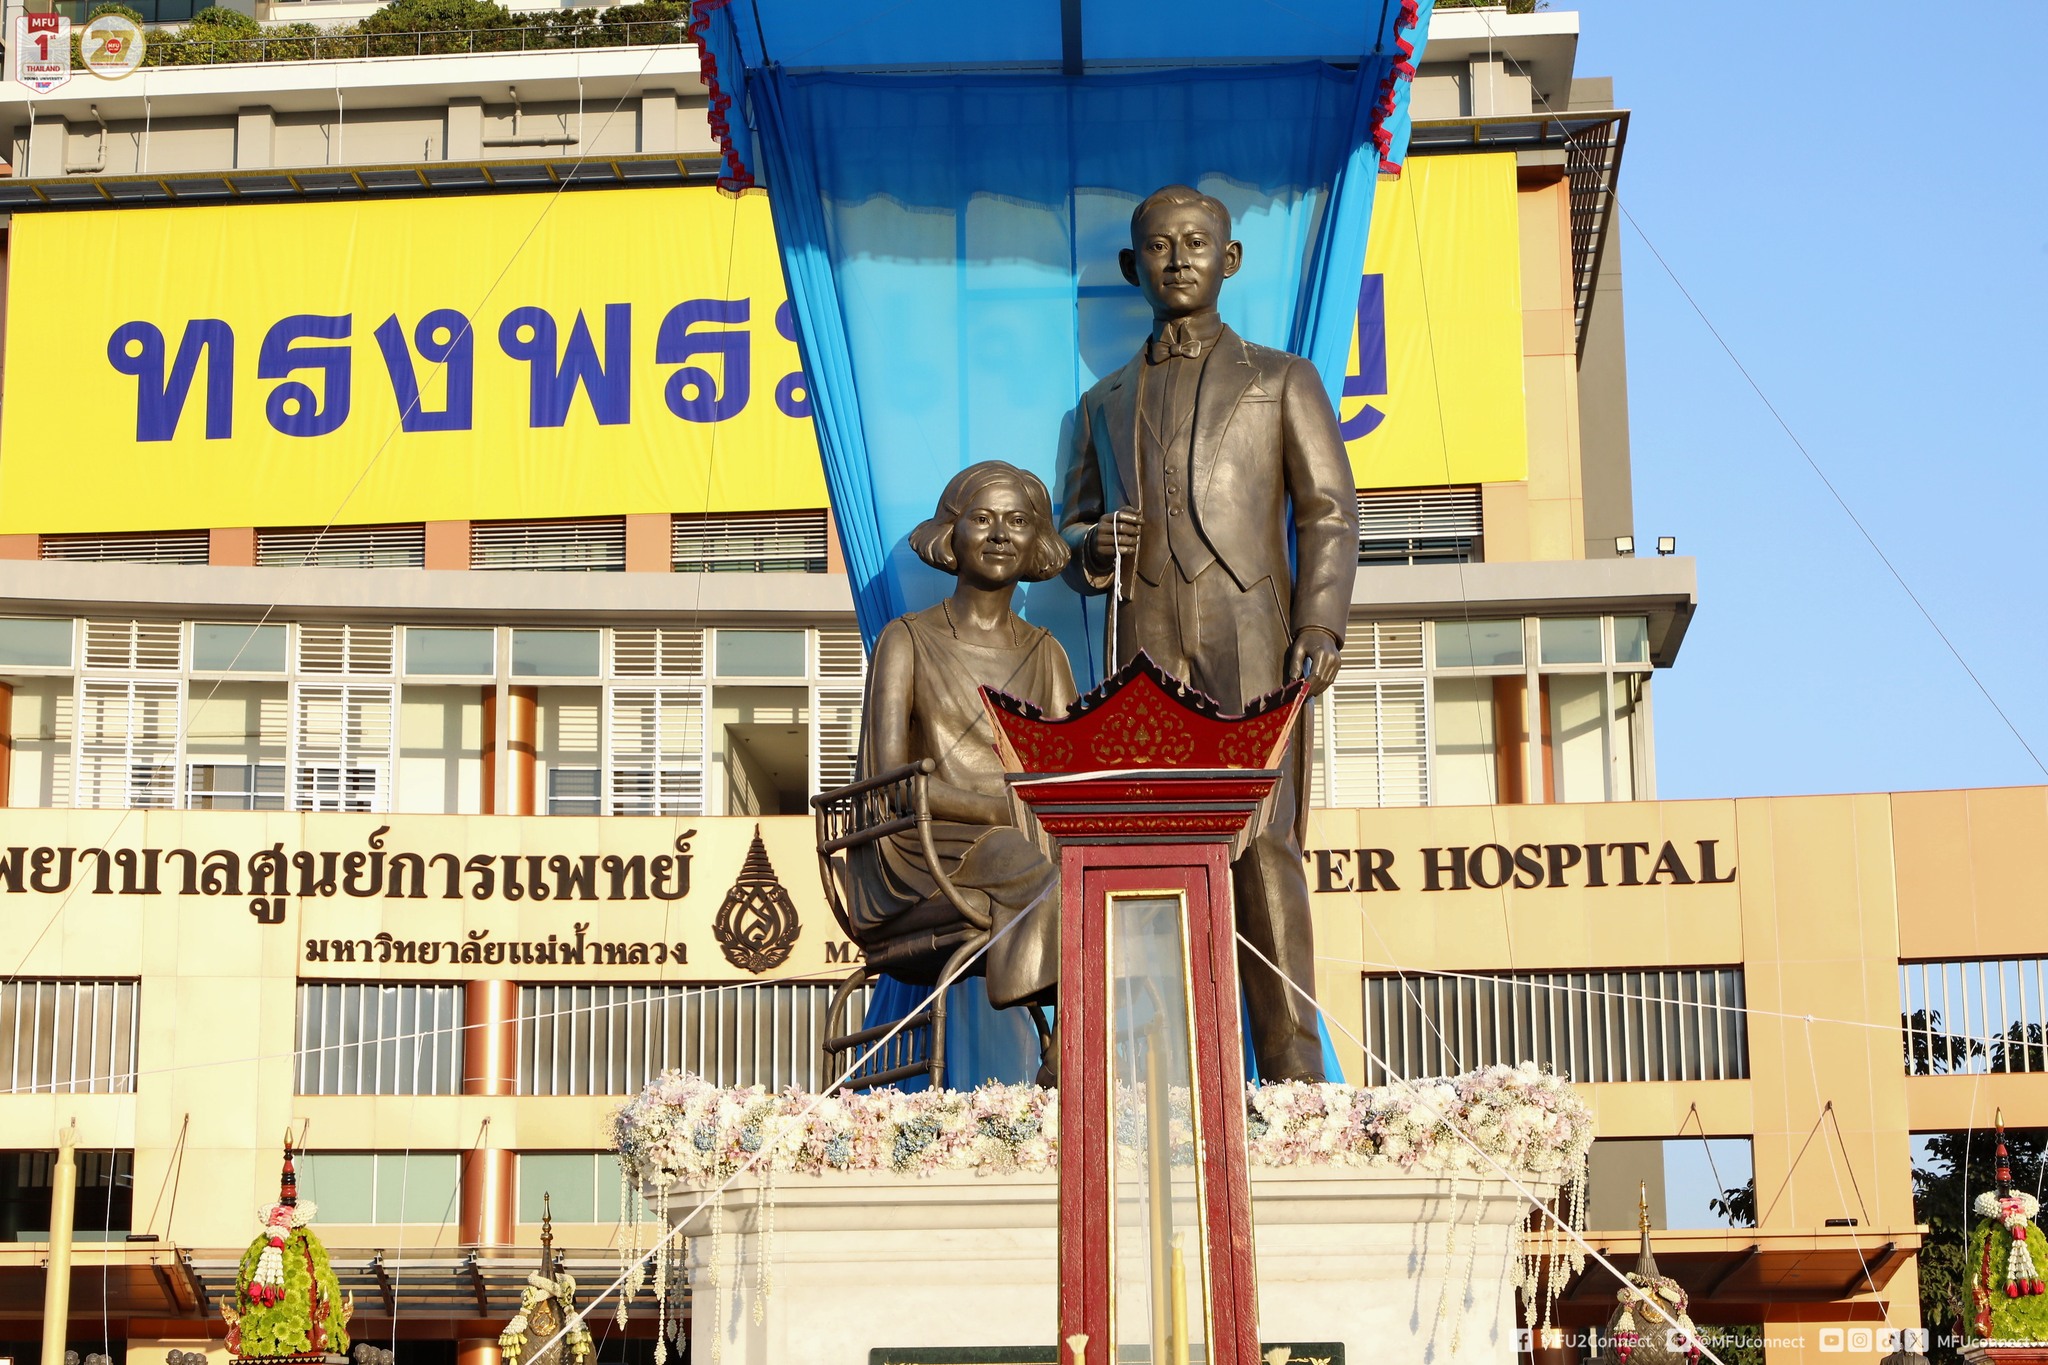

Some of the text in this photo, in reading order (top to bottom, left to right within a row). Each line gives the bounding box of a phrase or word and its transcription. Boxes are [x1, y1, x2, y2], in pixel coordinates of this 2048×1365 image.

[1303, 839, 1737, 893] ER HOSPITAL
[306, 922, 689, 965] มหาวิทยาลัยแม่ฟ้าหลวง
